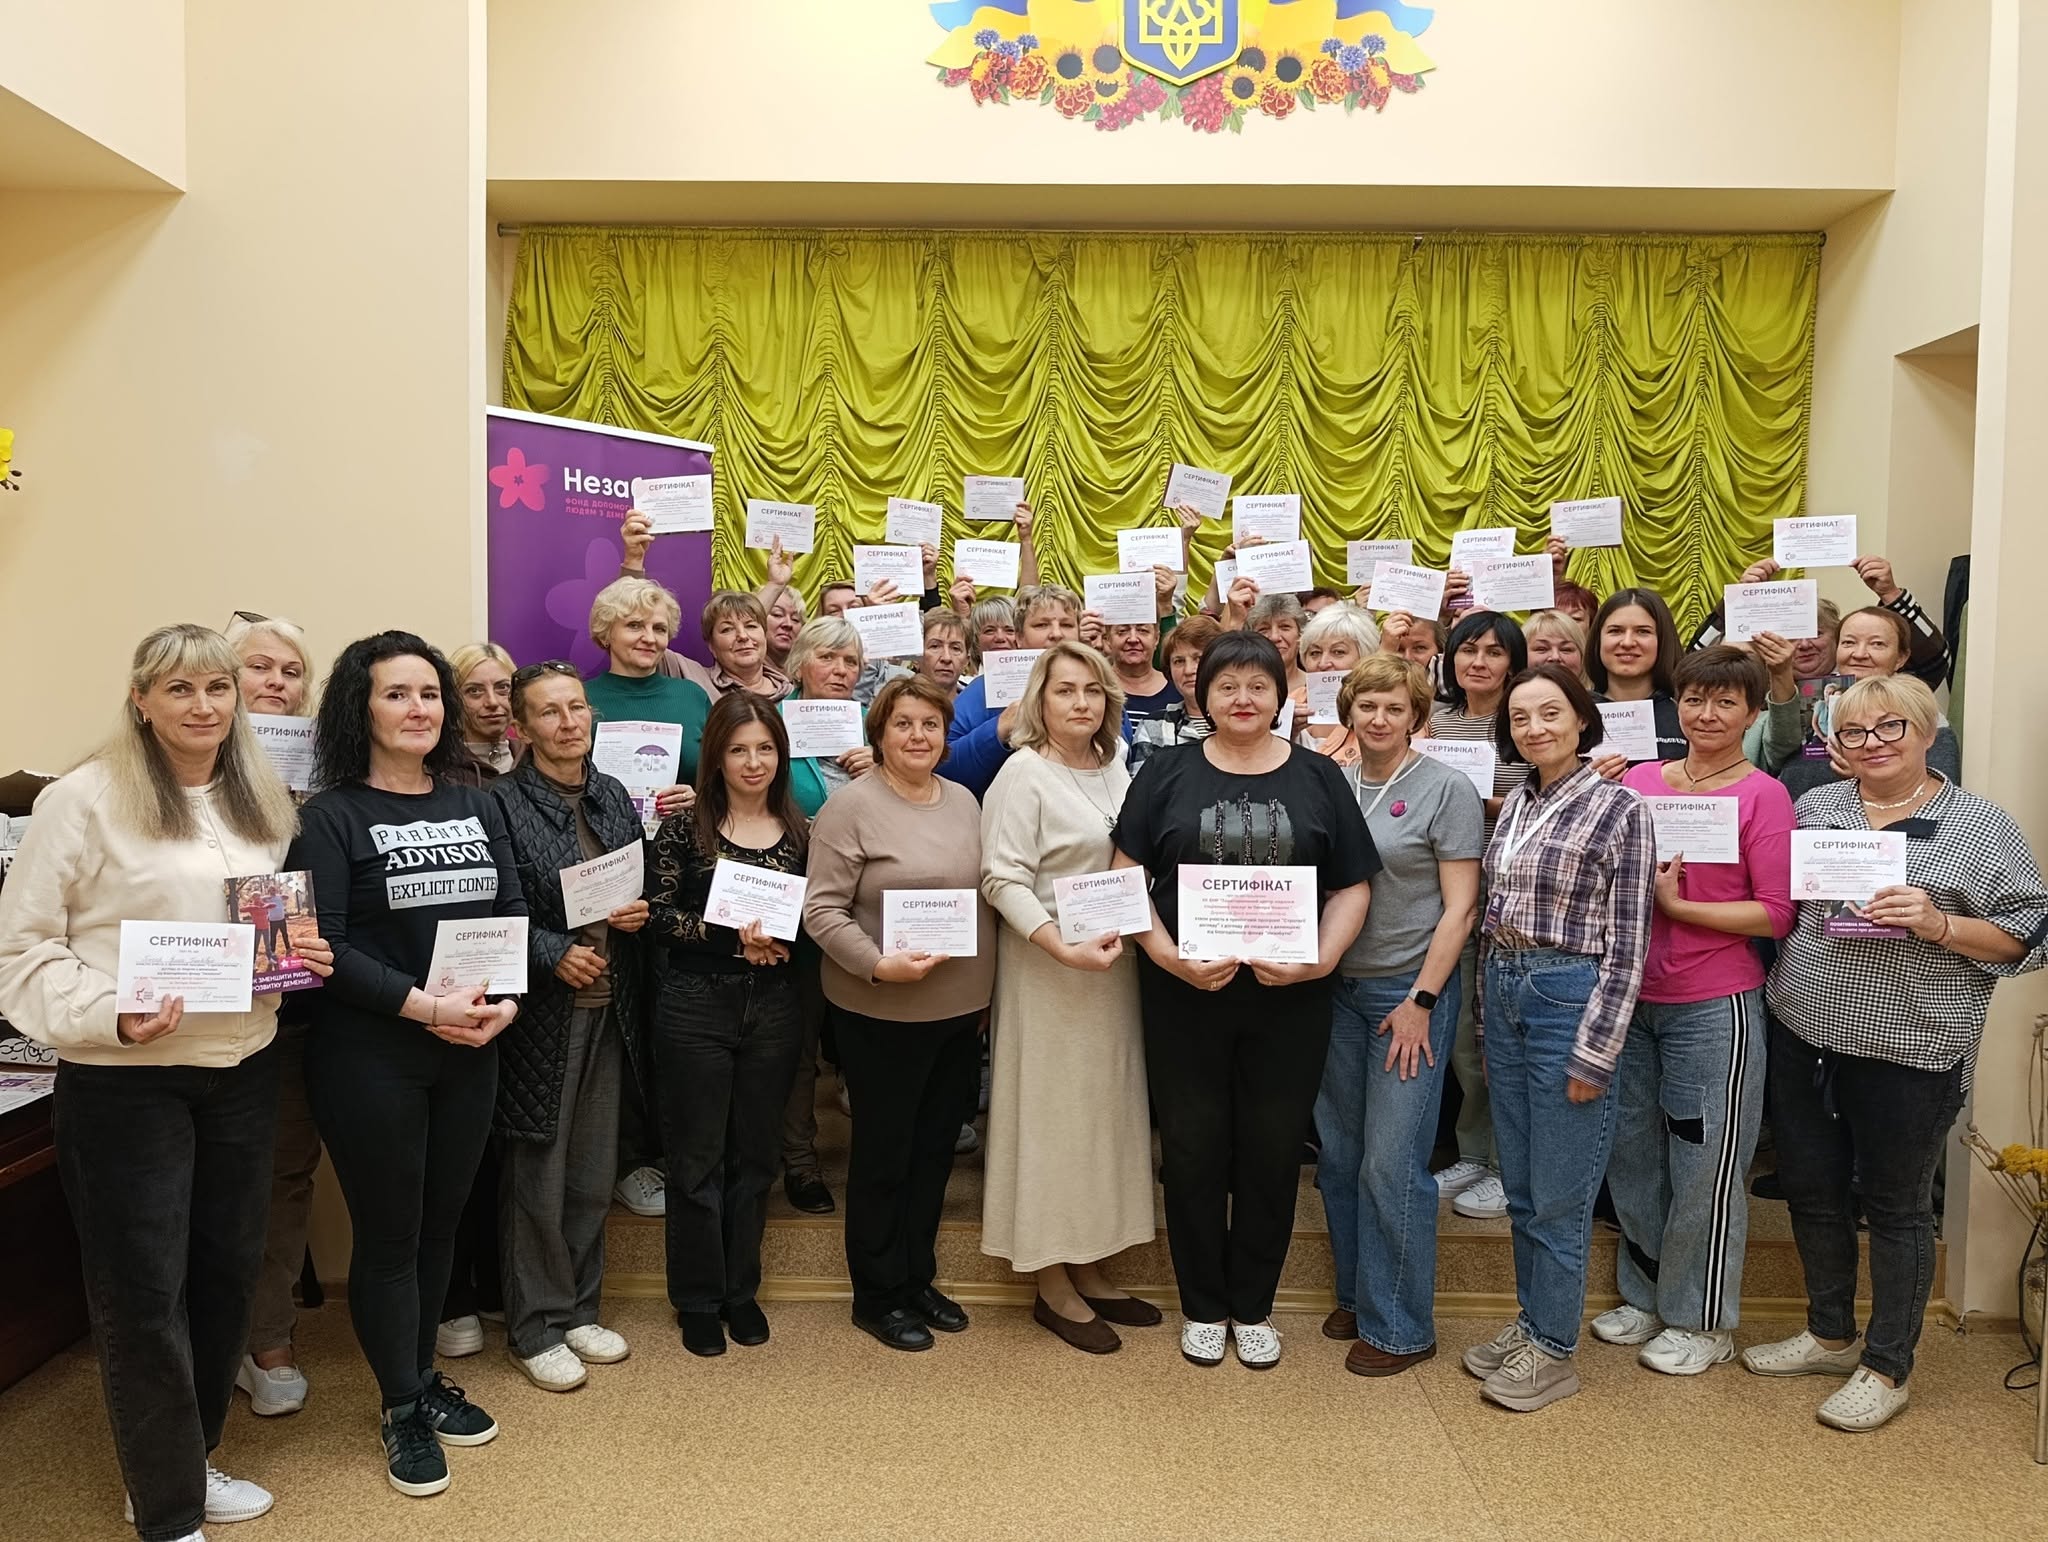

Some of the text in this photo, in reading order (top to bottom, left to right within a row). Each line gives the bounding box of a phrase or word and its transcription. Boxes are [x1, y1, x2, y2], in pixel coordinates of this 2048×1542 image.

[1184, 473, 1220, 485] СЕРТИФІКАТ
[649, 481, 695, 492] СЕРТИФІКАТ
[900, 503, 933, 512] СЕРТИФІКАТ
[1563, 504, 1606, 512] СЕРТИФІКАТ
[761, 508, 802, 518] СЕРТИФІКАТ
[1462, 536, 1502, 544] СЕРТИФІКАТ
[1251, 550, 1294, 560] СЕРТИФІКАТ
[1487, 560, 1535, 572] СЕРТИФІКАТ
[1389, 568, 1432, 579] СЕРТИФІКАТ
[1098, 581, 1140, 590] СЕРТИФІКАТ
[1742, 587, 1797, 596] СЕРТИФІКАТ
[860, 612, 904, 622] СЕРТИФІКАТ
[999, 656, 1040, 664] СЕРТИФІК
[1656, 803, 1717, 811] СЕРТИФІКАТ
[1814, 842, 1882, 850] СЕРТИФІКАТ
[385, 842, 494, 870] ADVISOR
[580, 852, 630, 878] СЕРТИФІКАТ
[734, 873, 788, 890] СЕРТИФІКАТ
[1072, 876, 1126, 890] СЕРТИФІКАТ
[1202, 879, 1292, 891] СЕРТИФІКАТ
[391, 877, 496, 900] EXPLICIT CONTE
[903, 900, 958, 908] СЕРТИФІКАТ
[456, 930, 508, 940] СЕРТИФІКАТ
[150, 936, 228, 948] СЕРТИФІКАТ
[259, 973, 292, 983] ЗМЕНШИТИ
[253, 982, 282, 991] ОЗВИТКУ
